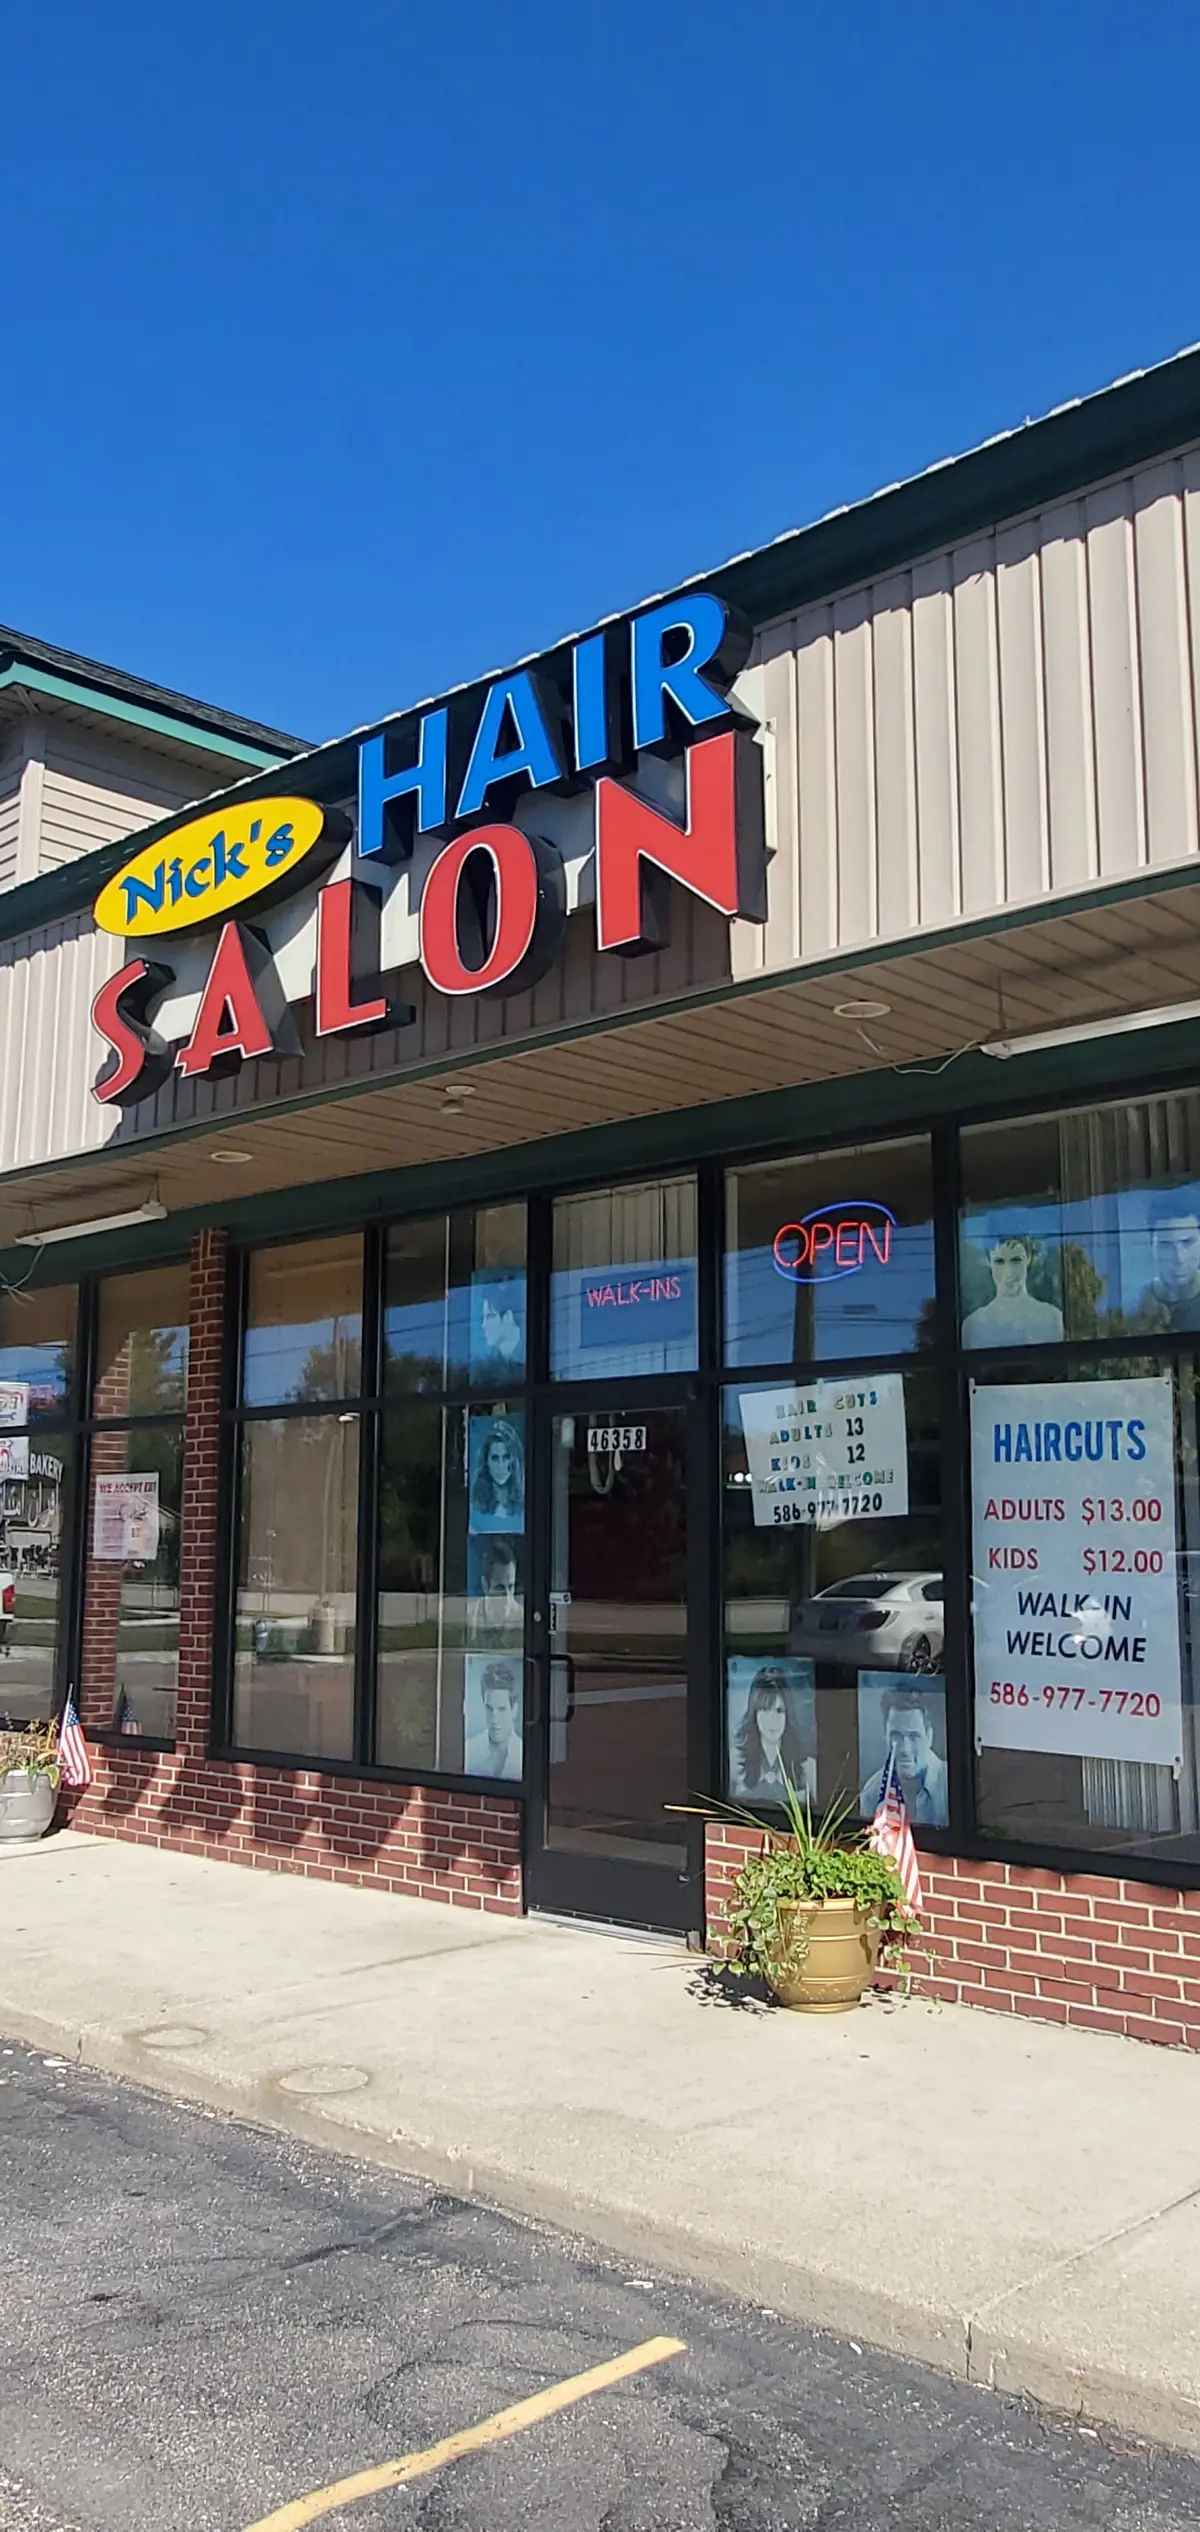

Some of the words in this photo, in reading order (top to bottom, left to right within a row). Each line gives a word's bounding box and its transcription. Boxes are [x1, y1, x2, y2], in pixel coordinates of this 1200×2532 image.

[358, 593, 733, 858] HAIR
[119, 819, 295, 926] Nick's
[92, 731, 740, 1104] SALON
[773, 1219, 892, 1267] OPEN
[586, 1276, 682, 1308] WALK-INS
[776, 1399, 817, 1419] HAIR
[834, 1391, 879, 1410] CUTS
[589, 1428, 644, 1450] 46358
[769, 1424, 833, 1445] ADULTS
[846, 1418, 864, 1437] 13
[993, 1420, 1147, 1463] HAIRCUTS
[30, 1452, 64, 1483] BAKERY
[770, 1455, 811, 1472] KIDS
[847, 1444, 865, 1464] 12
[773, 1493, 883, 1524] 586-977-7720
[984, 1499, 1066, 1522] ADULTS
[1081, 1497, 1163, 1526] $13.00
[988, 1547, 1040, 1571] KIDS
[1082, 1548, 1164, 1576] $12.00
[1017, 1591, 1133, 1622] WALK-IN
[1006, 1630, 1148, 1663] WELCOME
[989, 1682, 1161, 1718] 586-977-7720
